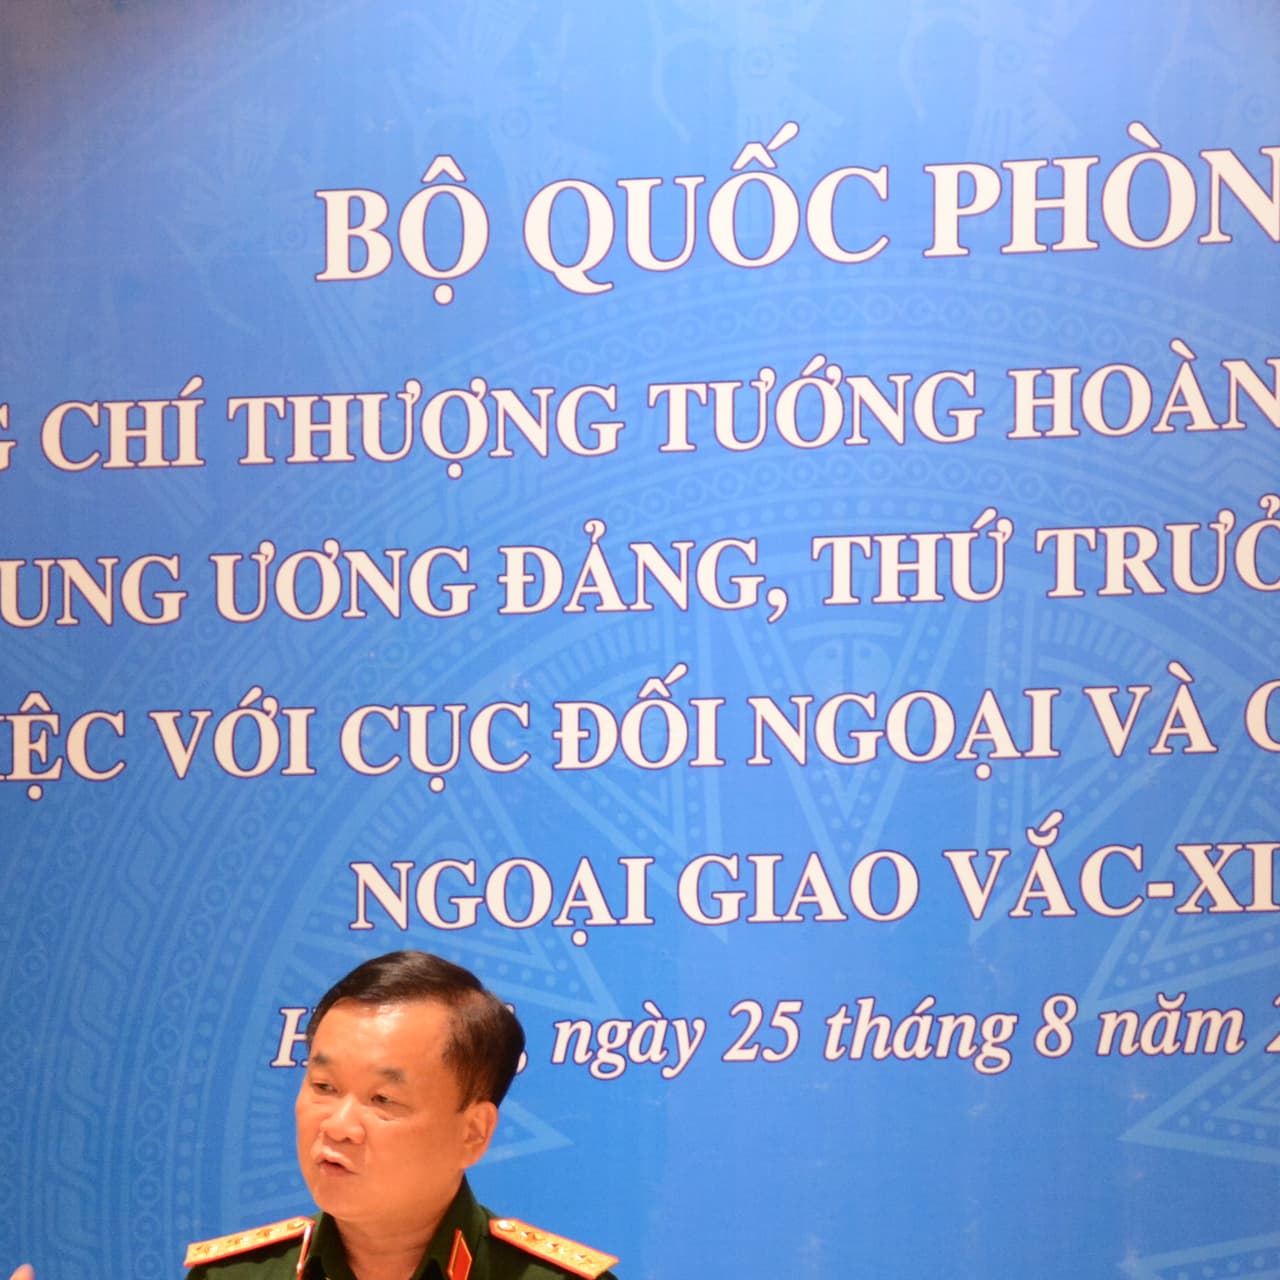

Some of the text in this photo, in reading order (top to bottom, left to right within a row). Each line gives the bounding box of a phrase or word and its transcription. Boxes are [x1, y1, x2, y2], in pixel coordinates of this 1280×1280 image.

[314, 154, 492, 308] BỘ
[521, 120, 892, 297] QUỐC
[40, 375, 206, 473] CHÍ
[226, 376, 626, 481] THƯỢNG
[647, 353, 985, 454] TƯỚNG
[208, 538, 478, 624] ƯƠNG
[497, 518, 789, 624] ĐẢNG,
[810, 506, 1015, 608] THỨ
[148, 685, 317, 780] VỚI
[339, 701, 531, 794] CỤC
[551, 662, 726, 771] ĐỐI
[746, 687, 1061, 781] NGOẠI
[1082, 660, 1219, 758] VÀ
[349, 856, 655, 947] NGOẠI
[676, 849, 920, 927] GIAO
[550, 1000, 707, 1081] ngày
[721, 999, 804, 1063] 25
[823, 995, 1019, 1076] tháng
[1033, 993, 1078, 1059] 8
[1096, 991, 1246, 1057] năm
